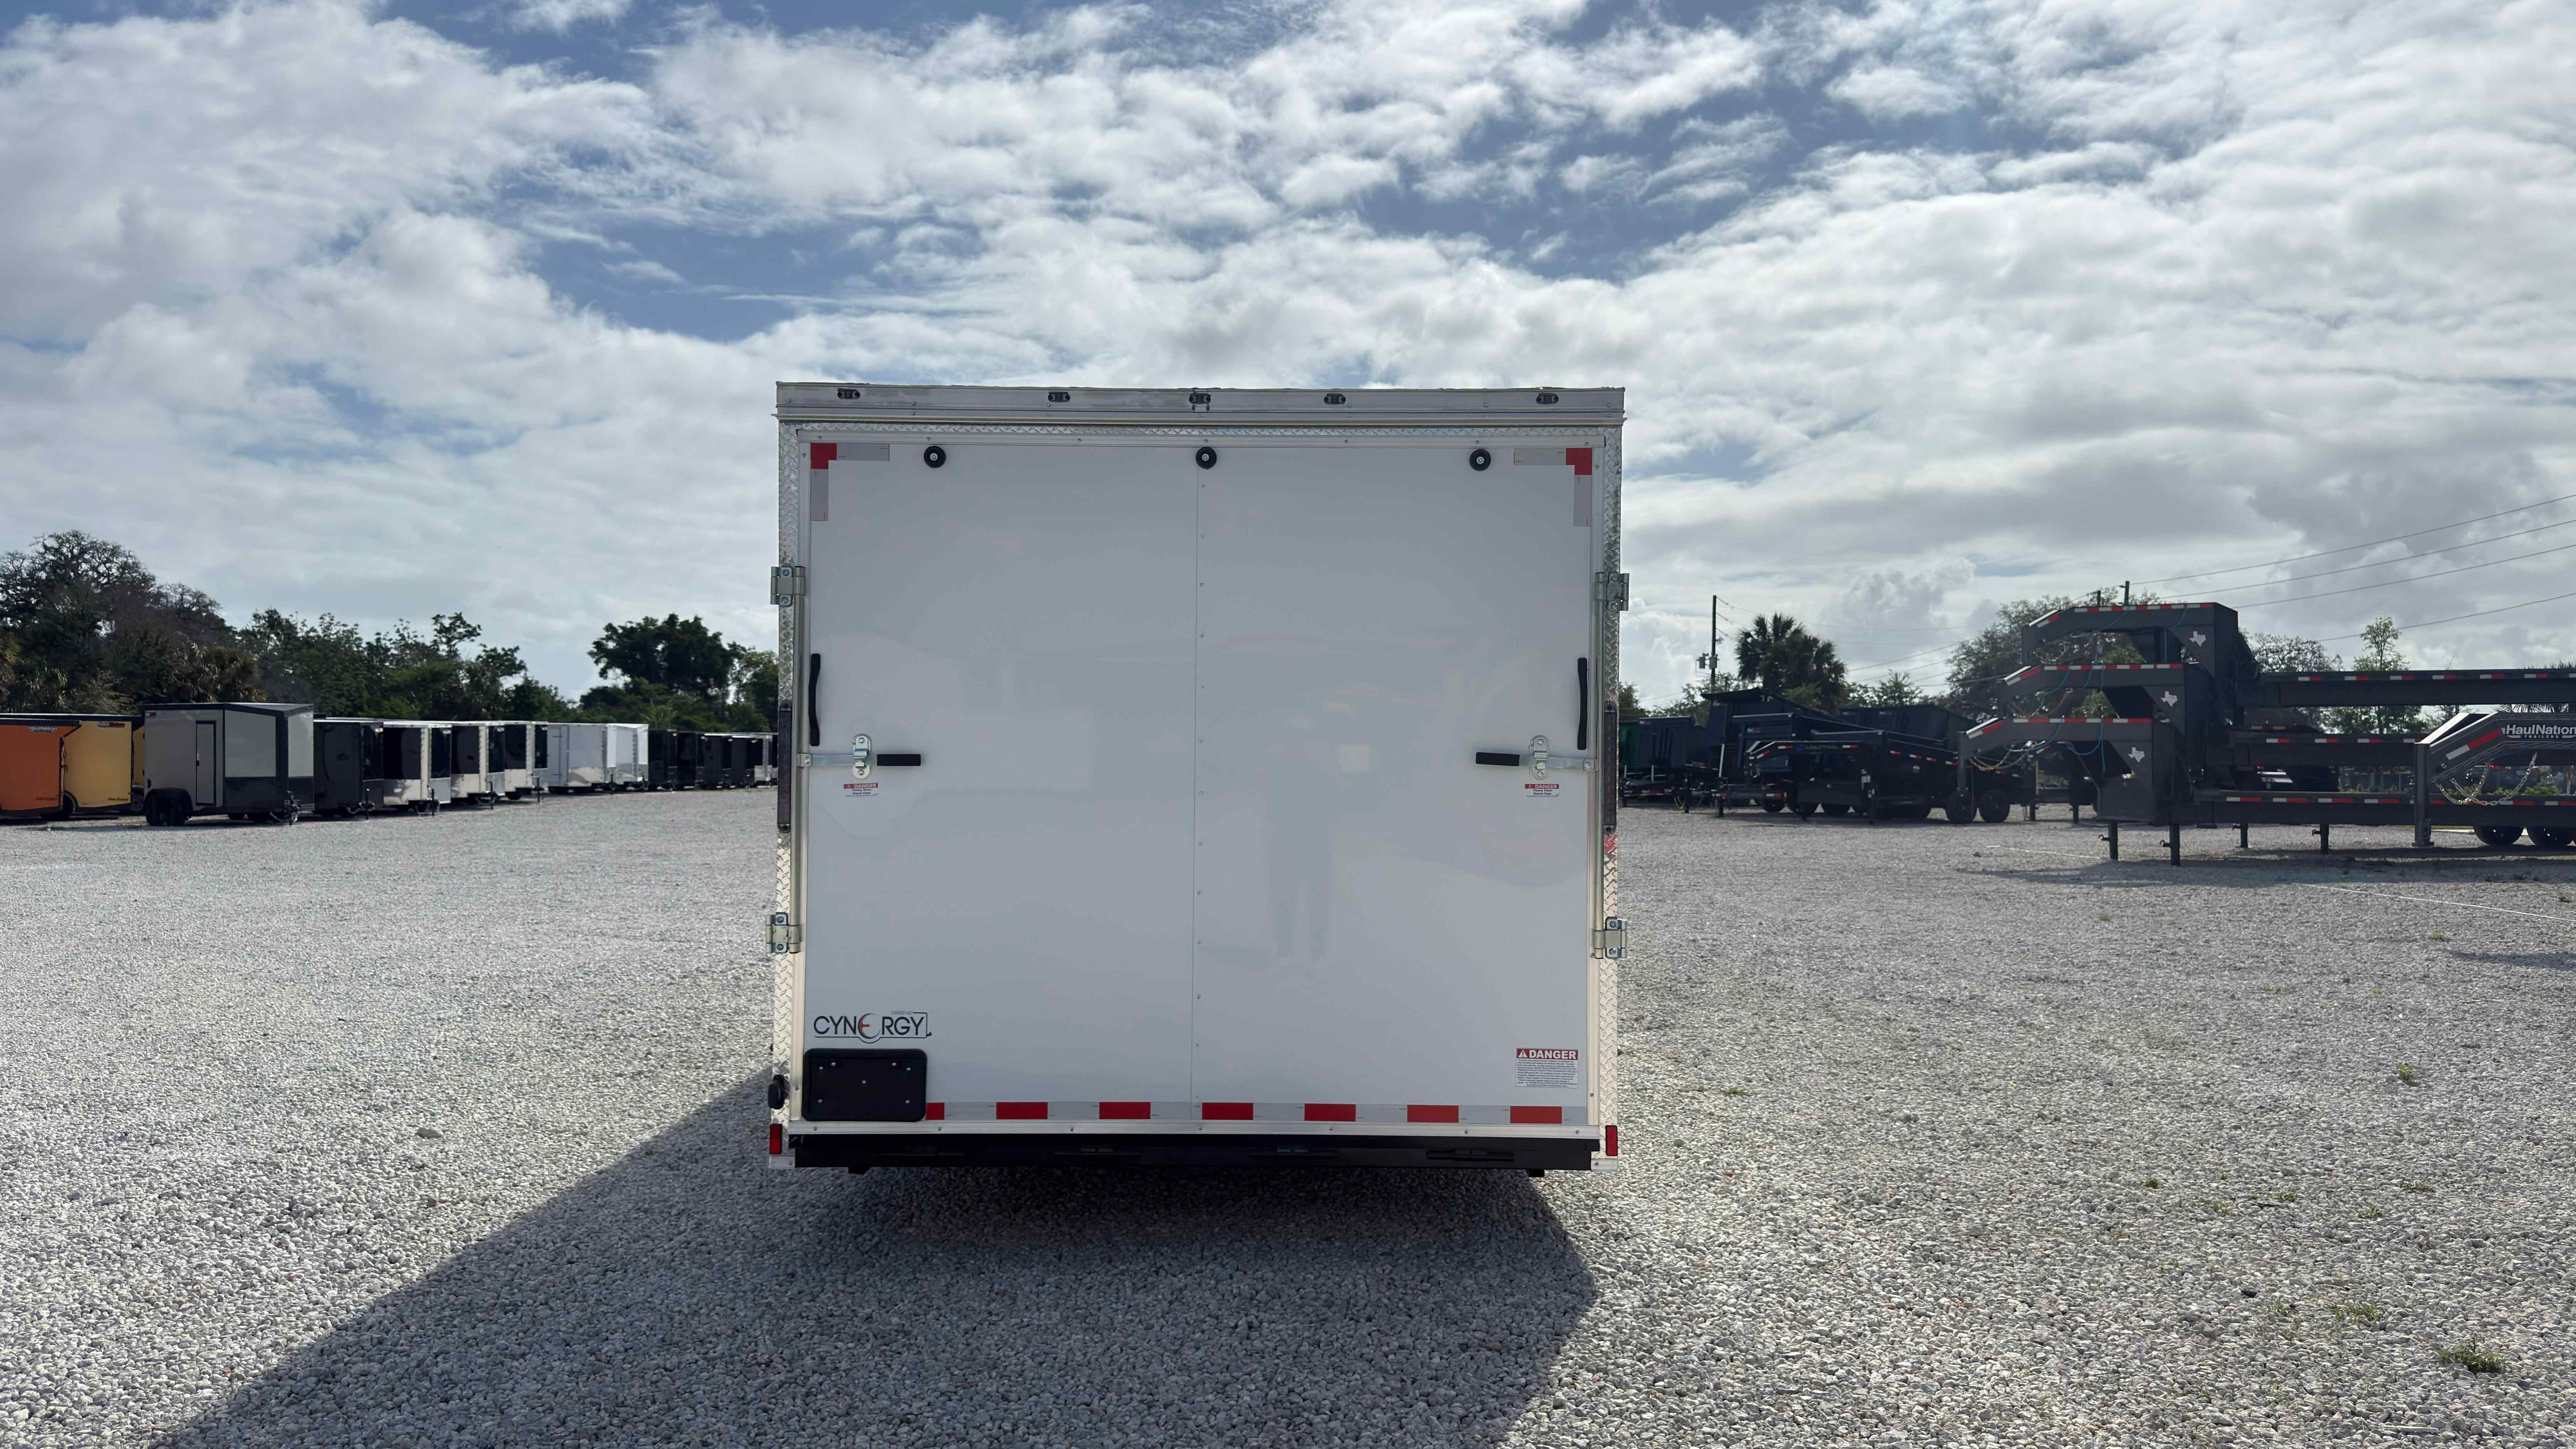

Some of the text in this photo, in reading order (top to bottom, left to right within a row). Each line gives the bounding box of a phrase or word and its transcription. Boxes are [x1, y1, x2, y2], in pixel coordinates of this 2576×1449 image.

[2506, 724, 2576, 735] HaulNation
[813, 1013, 924, 1039] CYNERGY
[1529, 1050, 1576, 1060] DANGER
